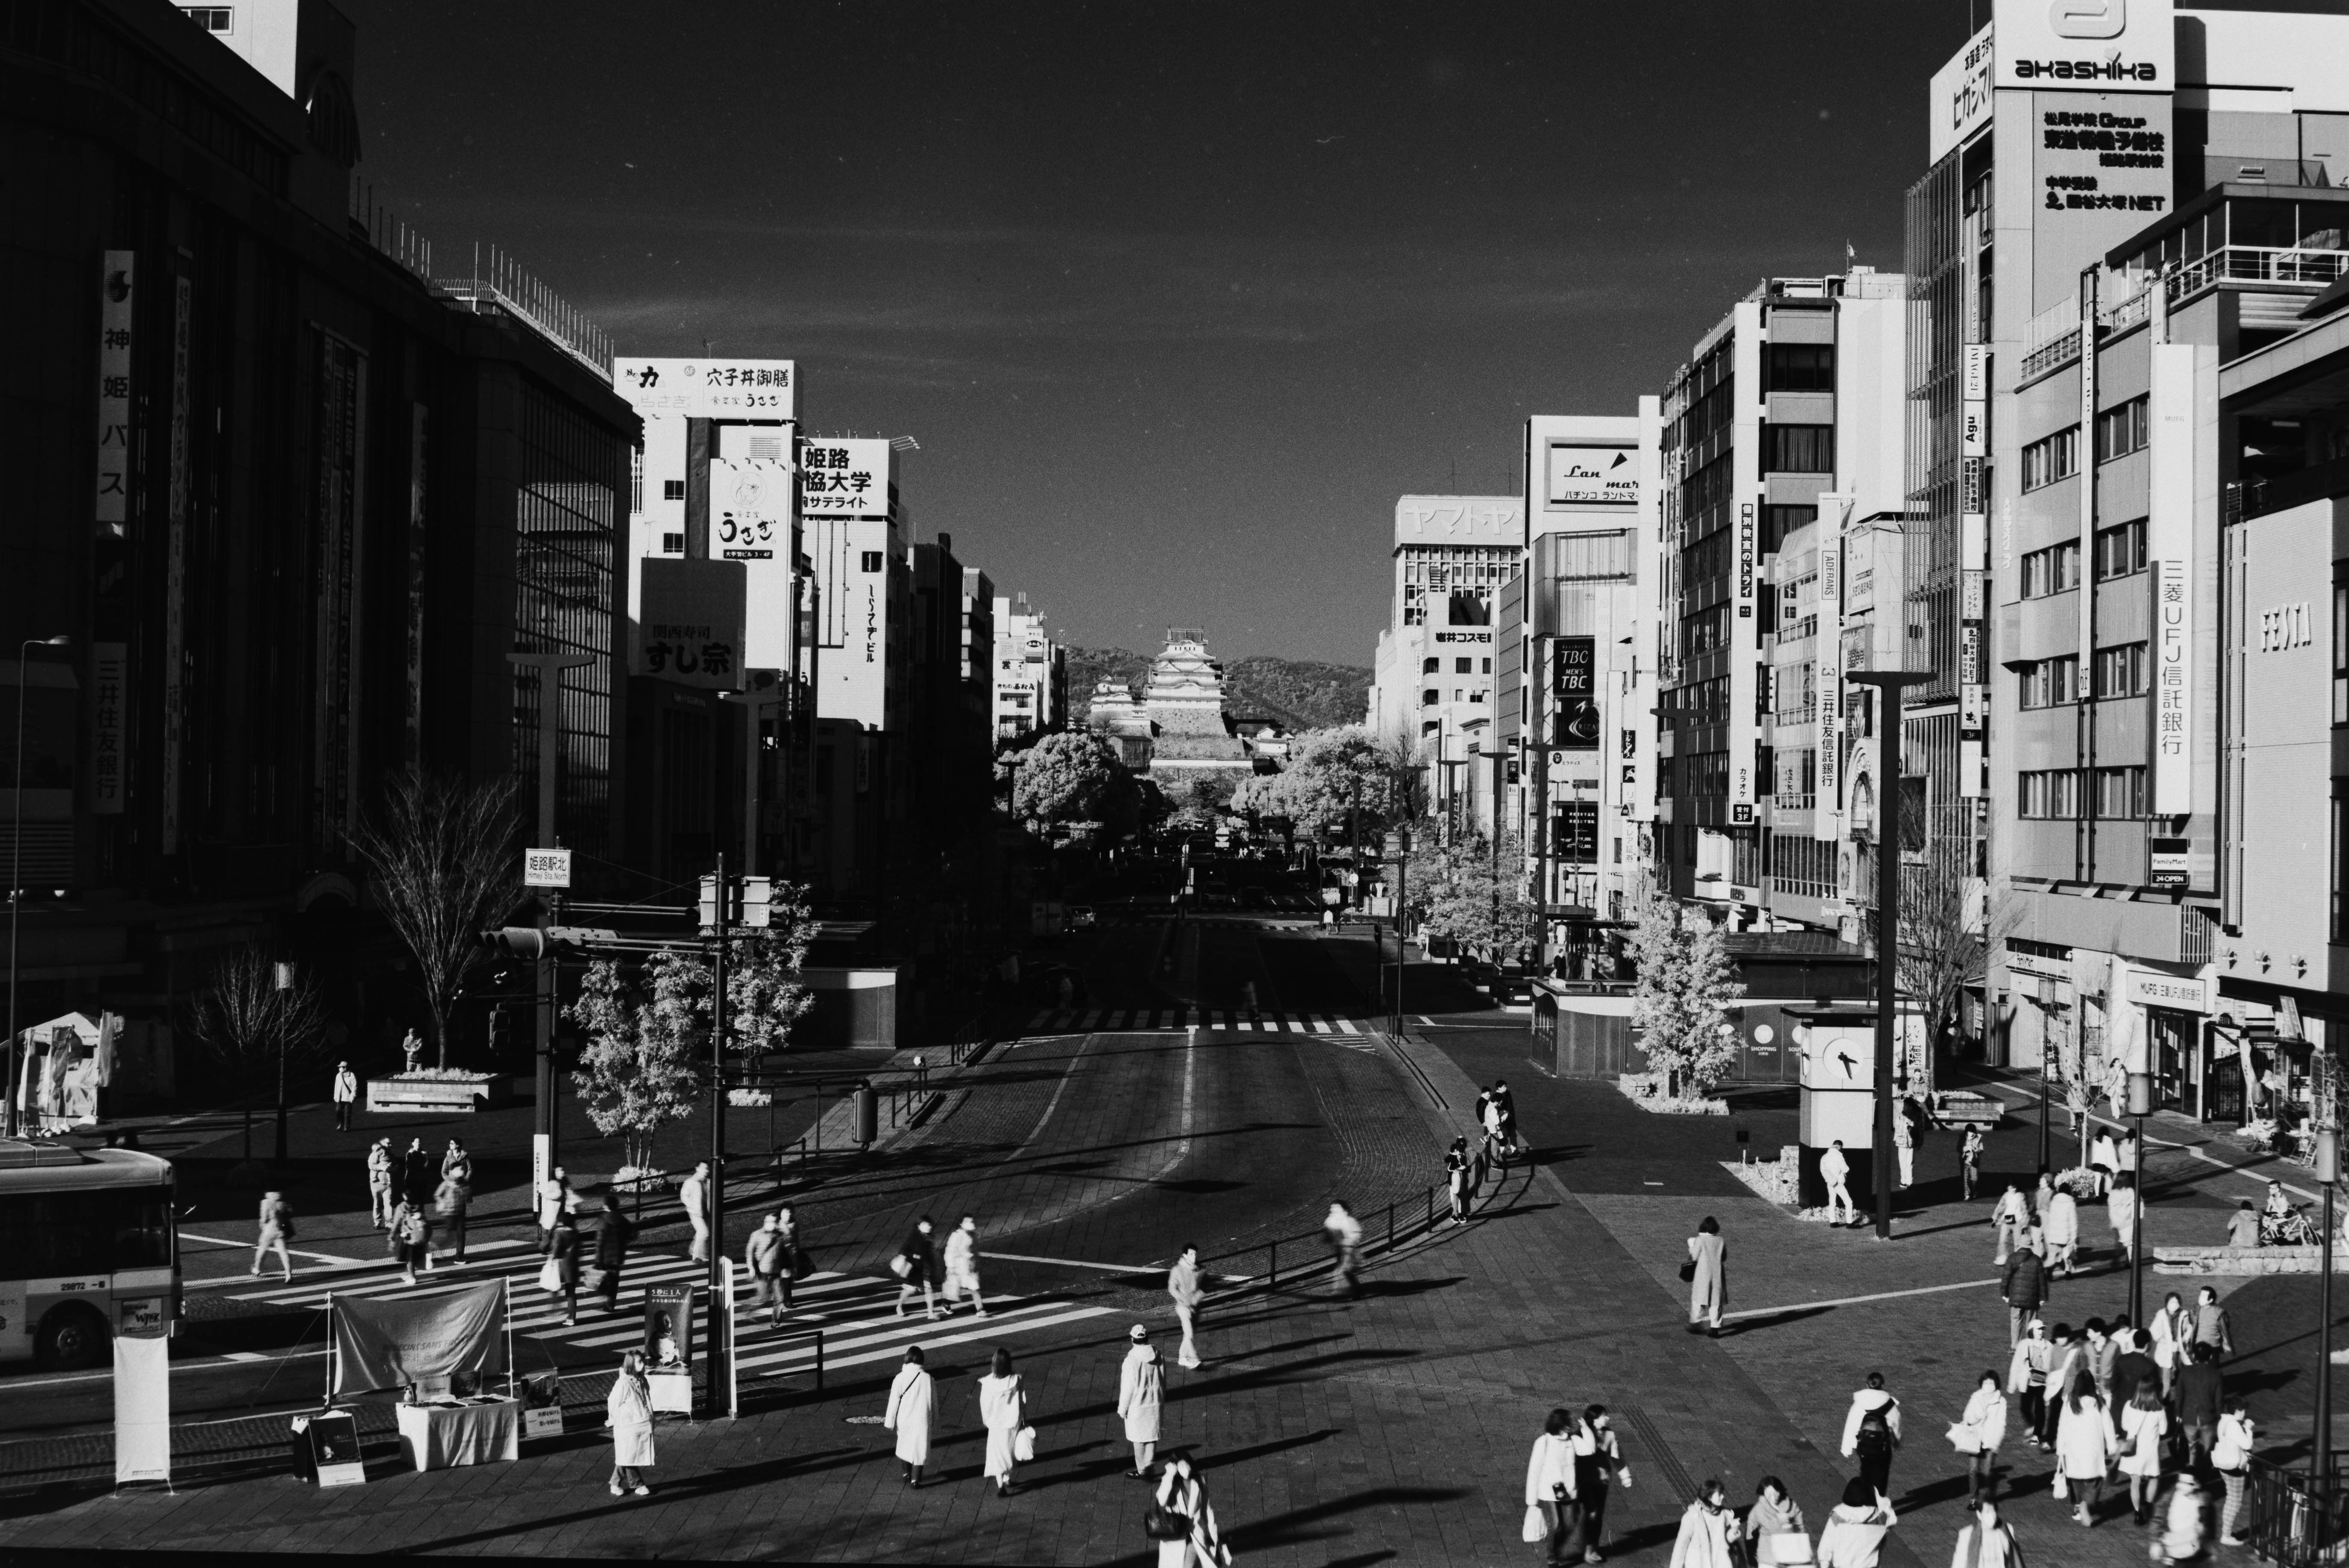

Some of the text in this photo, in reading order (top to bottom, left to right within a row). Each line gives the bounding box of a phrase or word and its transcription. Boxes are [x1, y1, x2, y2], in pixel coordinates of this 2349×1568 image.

[2015, 59, 2156, 80] akashika
[2045, 175, 2097, 191] 中学受験
[707, 369, 788, 387] 穴子丼御膳
[100, 328, 129, 495] 神姫バス
[745, 394, 781, 407] うさぎ
[1965, 414, 1977, 442] Agu.
[805, 447, 850, 469] 姫路
[719, 512, 776, 546] うさぎ
[1406, 505, 1523, 535] ヤマトヤ
[1741, 505, 1752, 596] 個別教室のトライ
[1824, 556, 1834, 595] ADERANS
[653, 624, 711, 640] 関西寿司
[2262, 602, 2311, 653] FESTA
[645, 641, 731, 676] すし宗
[1561, 650, 1589, 664] TBC
[2162, 560, 2183, 754] 三菱UFJ信託銀行
[1562, 676, 1588, 689] TBC
[96, 660, 119, 799] 三井住友銀行
[1822, 690, 1833, 787] 三井住友信託銀行
[528, 871, 542, 880] Himeji
[529, 856, 566, 871] 姫路駅北
[2140, 982, 2156, 995] MUFG
